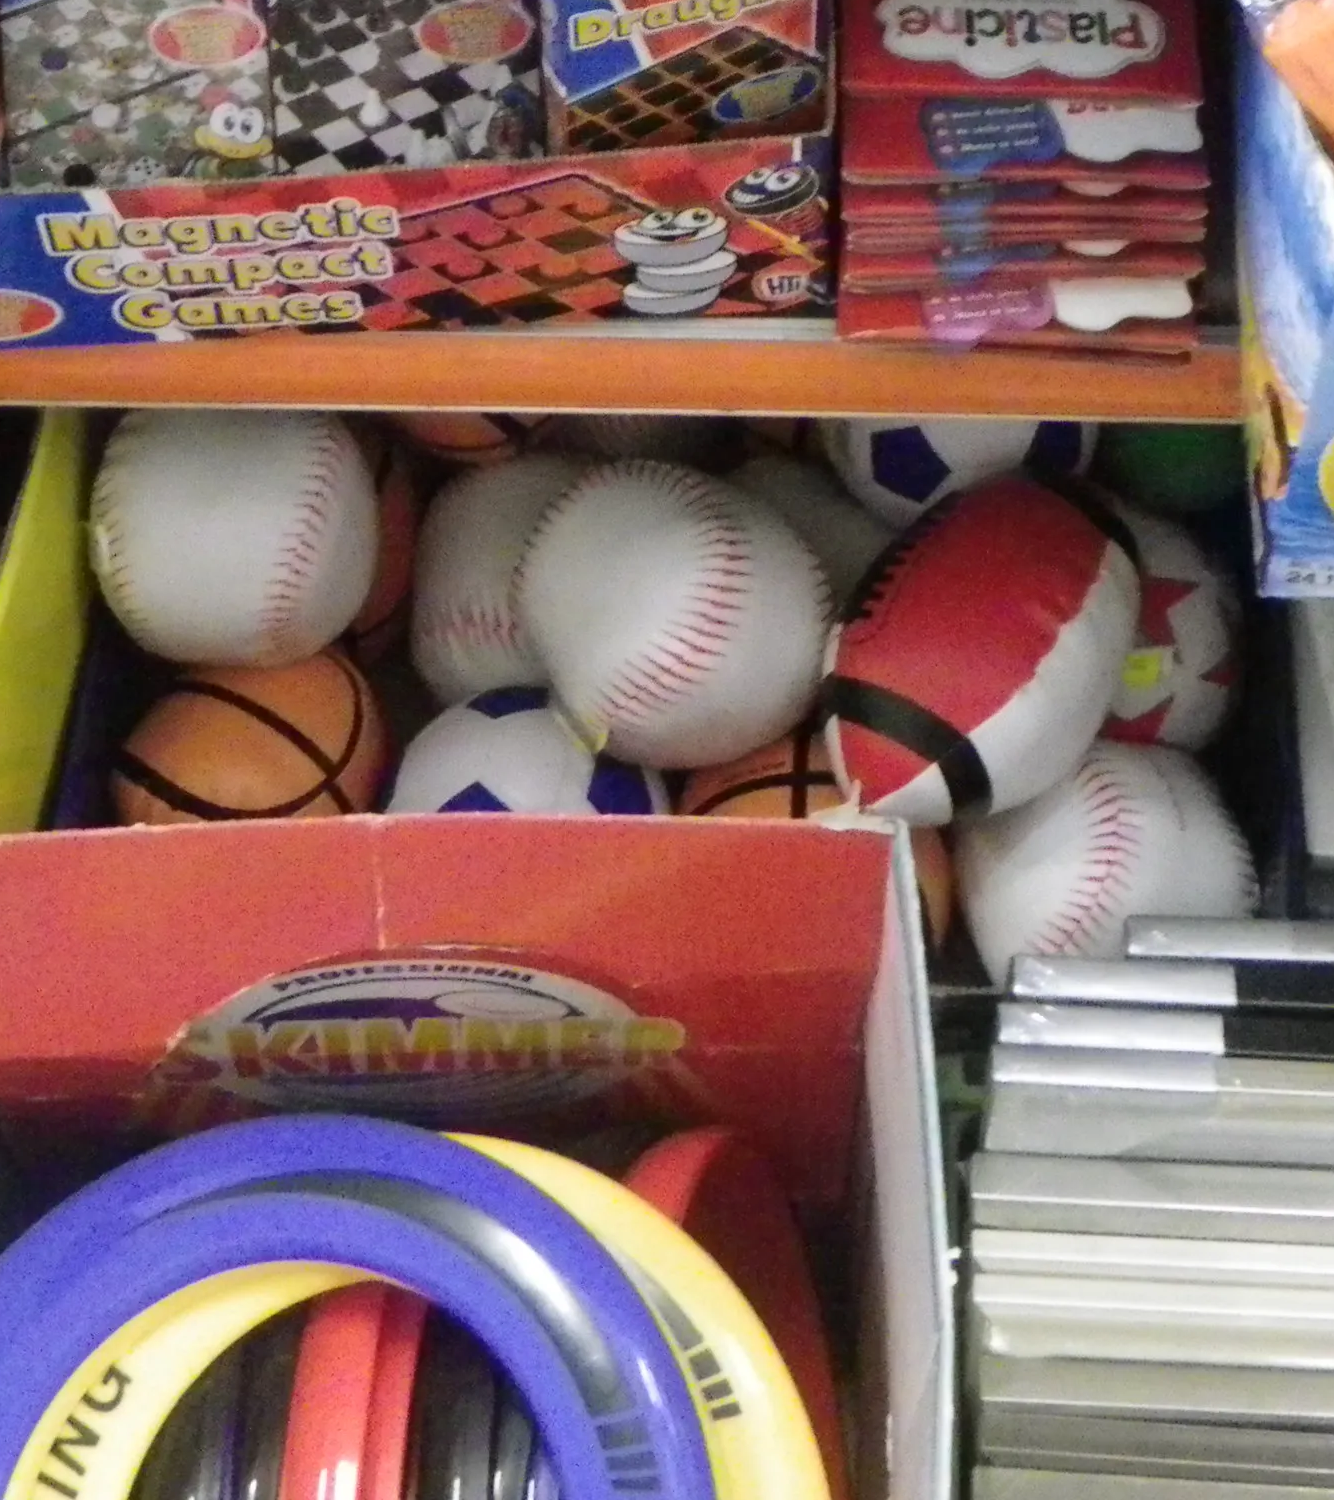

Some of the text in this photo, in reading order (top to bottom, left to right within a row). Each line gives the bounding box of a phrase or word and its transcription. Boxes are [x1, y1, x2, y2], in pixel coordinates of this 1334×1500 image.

[897, 4, 1148, 49] Plasticine
[42, 197, 397, 256] Magnetic
[69, 242, 389, 292] Compact
[118, 291, 359, 331] Games
[157, 1016, 687, 1088] SKIMMER
[37, 1363, 133, 1500] ING
